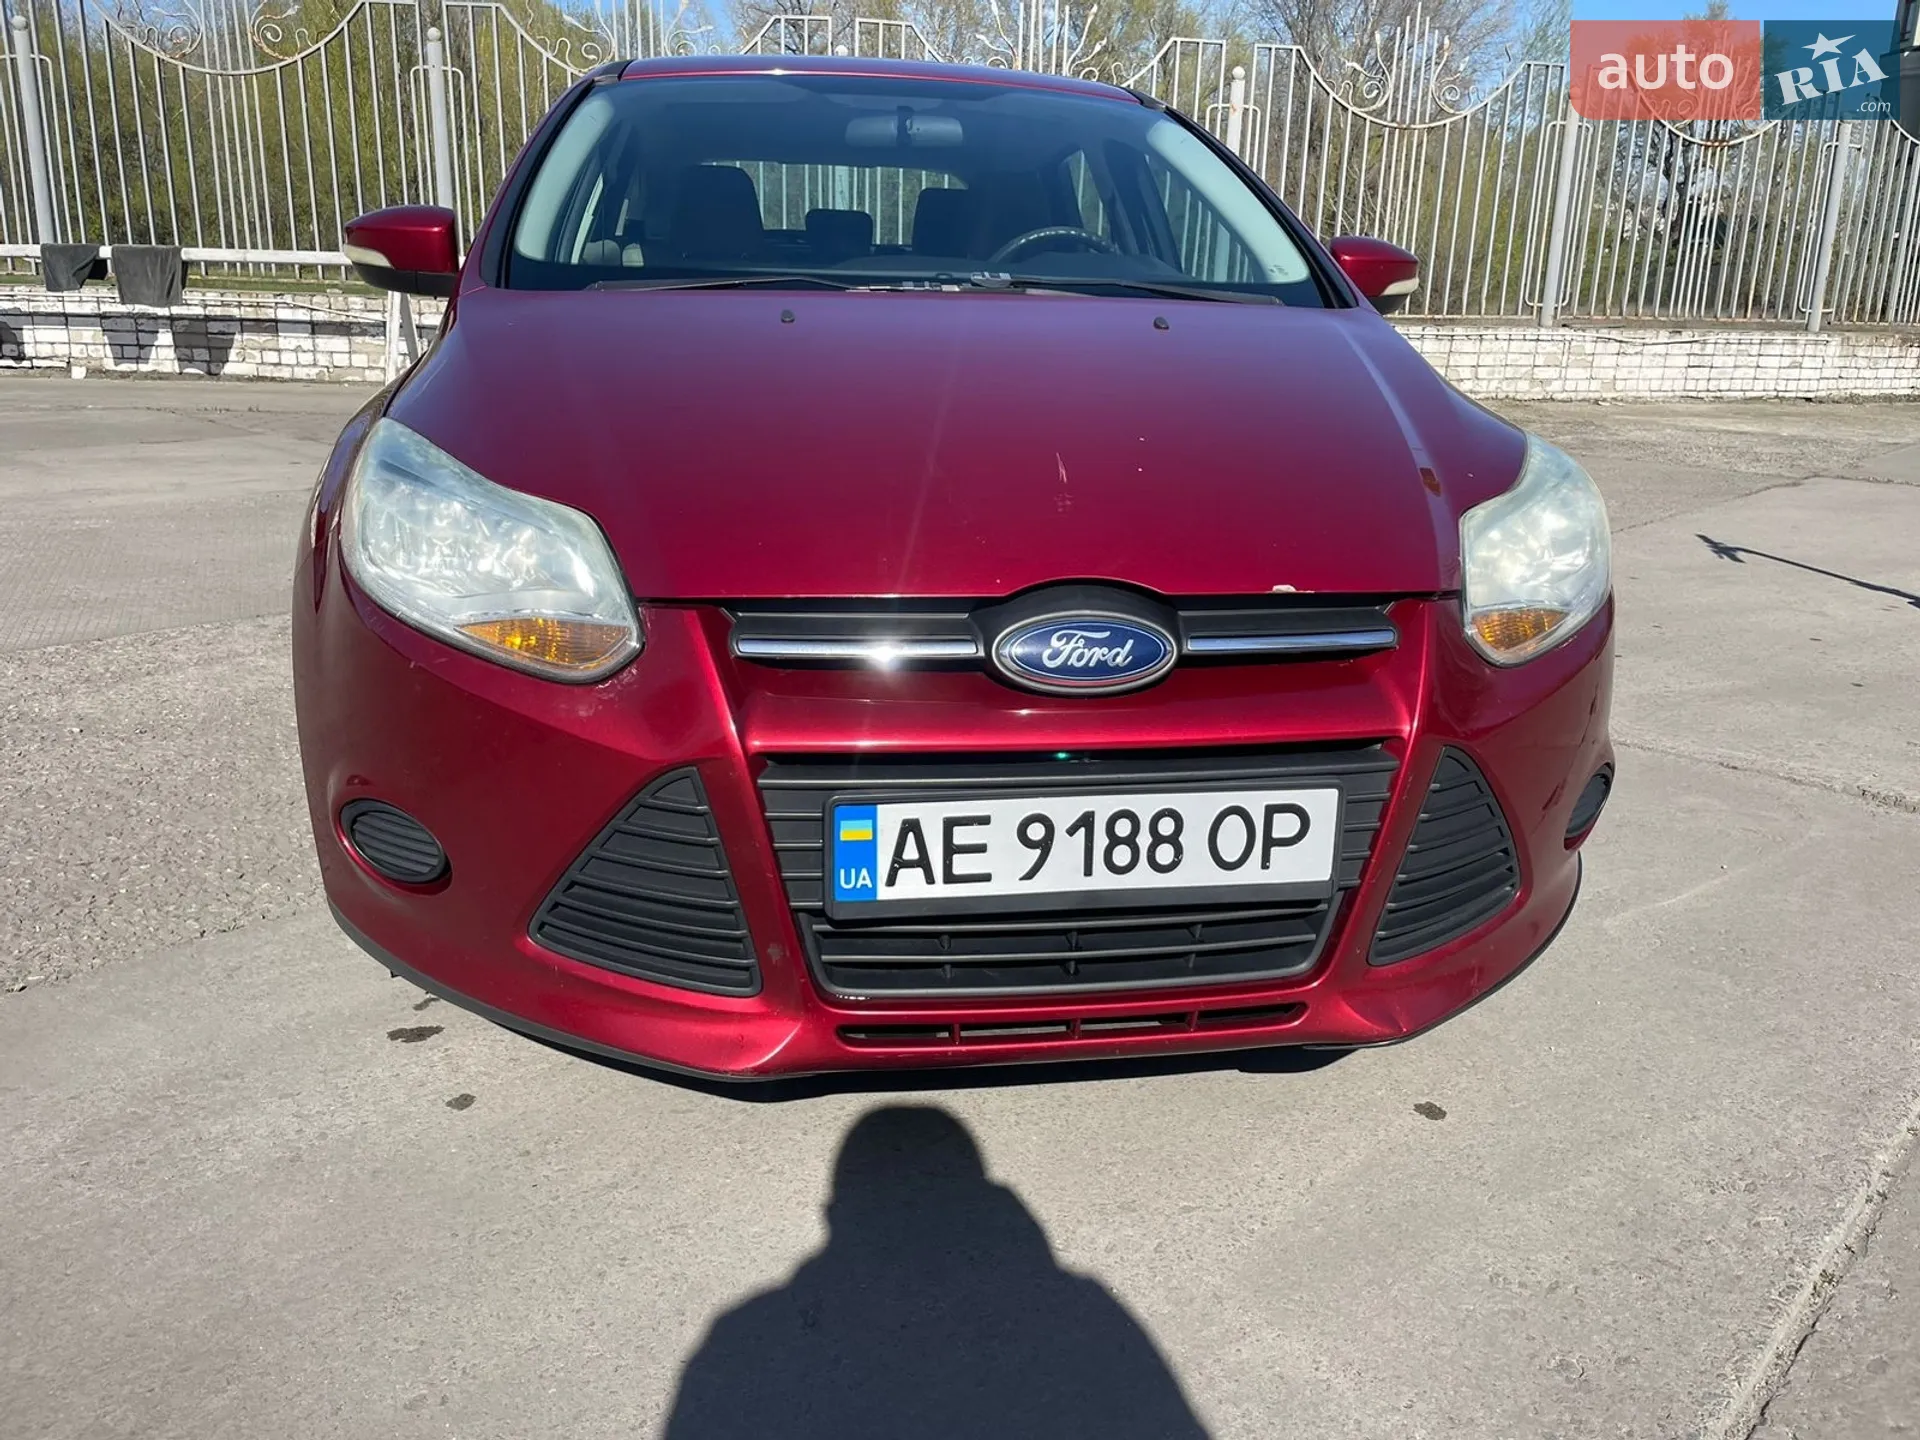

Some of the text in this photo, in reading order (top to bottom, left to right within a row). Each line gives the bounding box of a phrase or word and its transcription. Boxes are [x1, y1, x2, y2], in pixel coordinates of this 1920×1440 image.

[1041, 629, 1134, 668] Ford
[885, 803, 1311, 887] AE 9188 OP
[840, 868, 872, 889] UA
